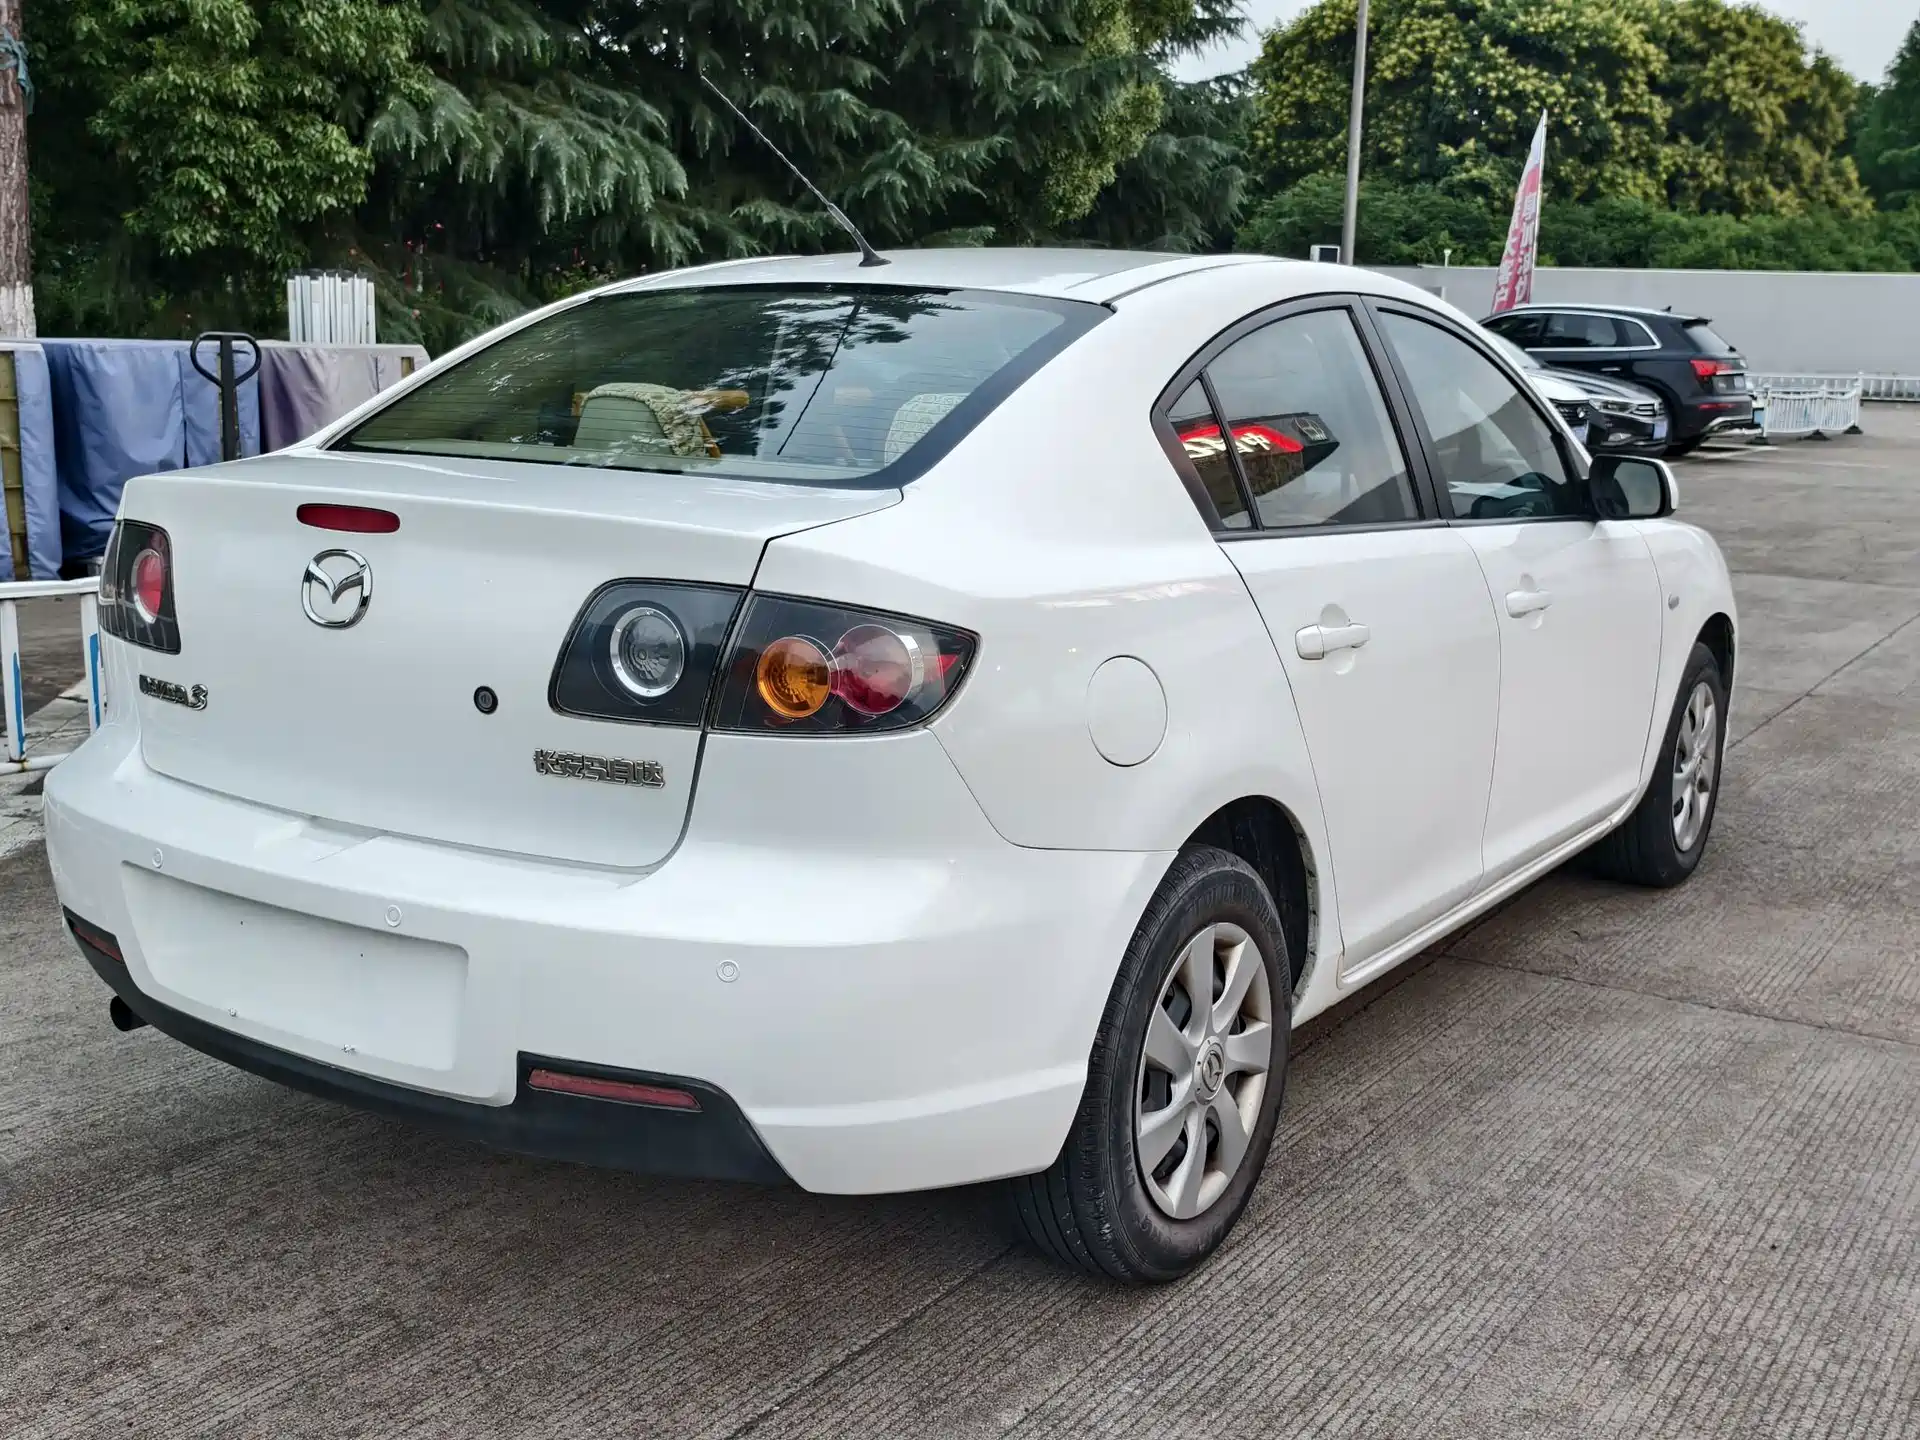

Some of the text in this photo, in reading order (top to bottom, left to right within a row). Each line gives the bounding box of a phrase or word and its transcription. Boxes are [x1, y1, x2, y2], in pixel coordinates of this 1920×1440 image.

[533, 748, 665, 789] 长安马自达
